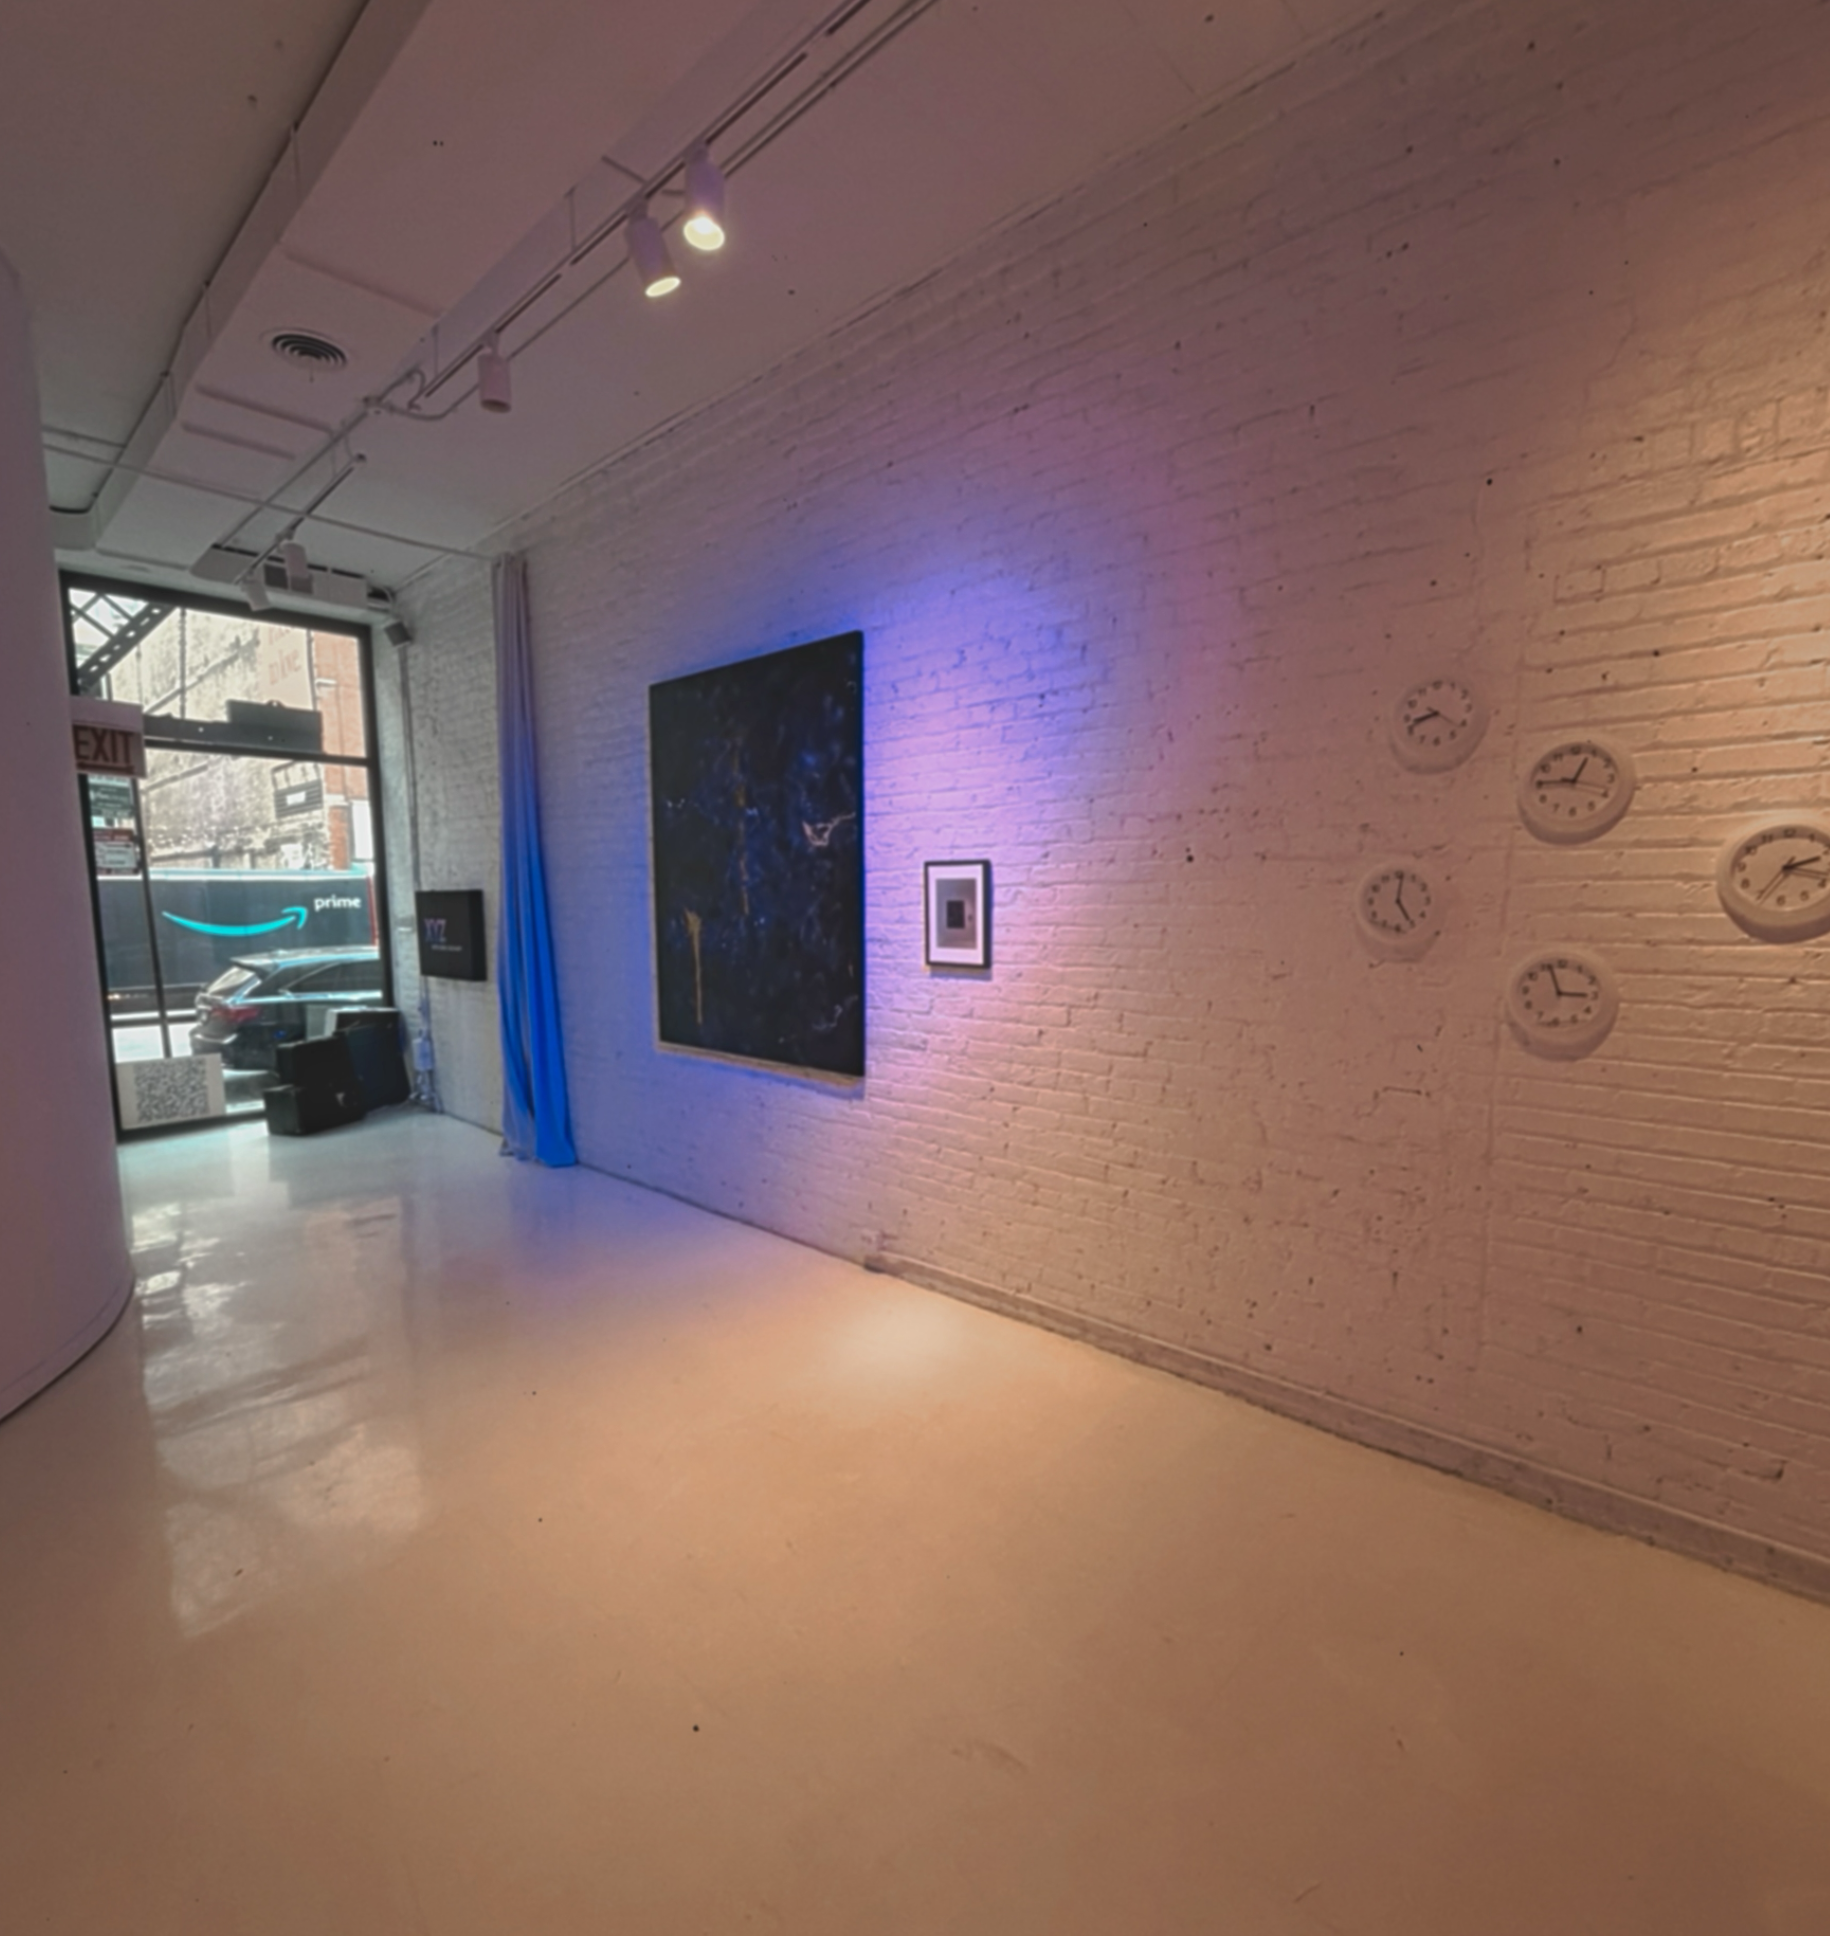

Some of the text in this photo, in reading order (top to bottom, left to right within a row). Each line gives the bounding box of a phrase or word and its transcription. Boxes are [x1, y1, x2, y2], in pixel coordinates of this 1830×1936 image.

[1432, 680, 1443, 690] 12
[1450, 682, 1456, 690] 1
[1418, 687, 1427, 696] 11
[1461, 688, 1469, 700] 2
[1407, 699, 1418, 709] 10
[1465, 703, 1473, 713] 3
[1403, 713, 1411, 723] 9
[1460, 718, 1467, 727] 4
[1419, 734, 1426, 744] 7
[1449, 729, 1456, 740] 5
[72, 724, 136, 765] EXIT
[1432, 736, 1441, 746] 6
[1571, 745, 1582, 755] 12
[1591, 749, 1597, 758] 1
[1553, 753, 1564, 763] 11
[1603, 758, 1612, 769] 2
[1541, 763, 1551, 774] 10
[1607, 773, 1615, 785] 3
[1538, 794, 1548, 805] 8
[1601, 789, 1609, 799] 4
[1552, 803, 1560, 814] 7
[1568, 806, 1577, 818] 6
[1587, 801, 1596, 812] 5
[1784, 827, 1797, 838] 12
[1808, 833, 1815, 843] 1
[1761, 834, 1774, 844] 11
[1745, 845, 1758, 857] 10
[1737, 861, 1747, 873] 9
[1381, 874, 1390, 884] 11
[1410, 873, 1416, 883] 1
[1817, 877, 1827, 889] 4
[1371, 883, 1381, 893] 10
[1420, 881, 1428, 893] 2
[1740, 878, 1751, 890] 8
[1367, 896, 1375, 907] 9
[1424, 895, 1431, 906] 3
[1776, 894, 1786, 907] 6
[1800, 890, 1810, 903] 5
[314, 894, 362, 912] prime
[1371, 909, 1378, 920] 8
[1419, 910, 1427, 919] 4
[1381, 919, 1388, 928] 7
[1393, 923, 1402, 934] 6
[1557, 959, 1569, 969] 12
[1577, 964, 1583, 975] 1
[1528, 971, 1539, 982] 10
[1588, 974, 1597, 986] 2
[1521, 985, 1530, 996] 9
[1590, 991, 1599, 1001] 3
[1524, 1000, 1533, 1011] 8
[1583, 1005, 1592, 1014] 4
[1535, 1010, 1545, 1021] 7
[1570, 1013, 1579, 1025] 5
